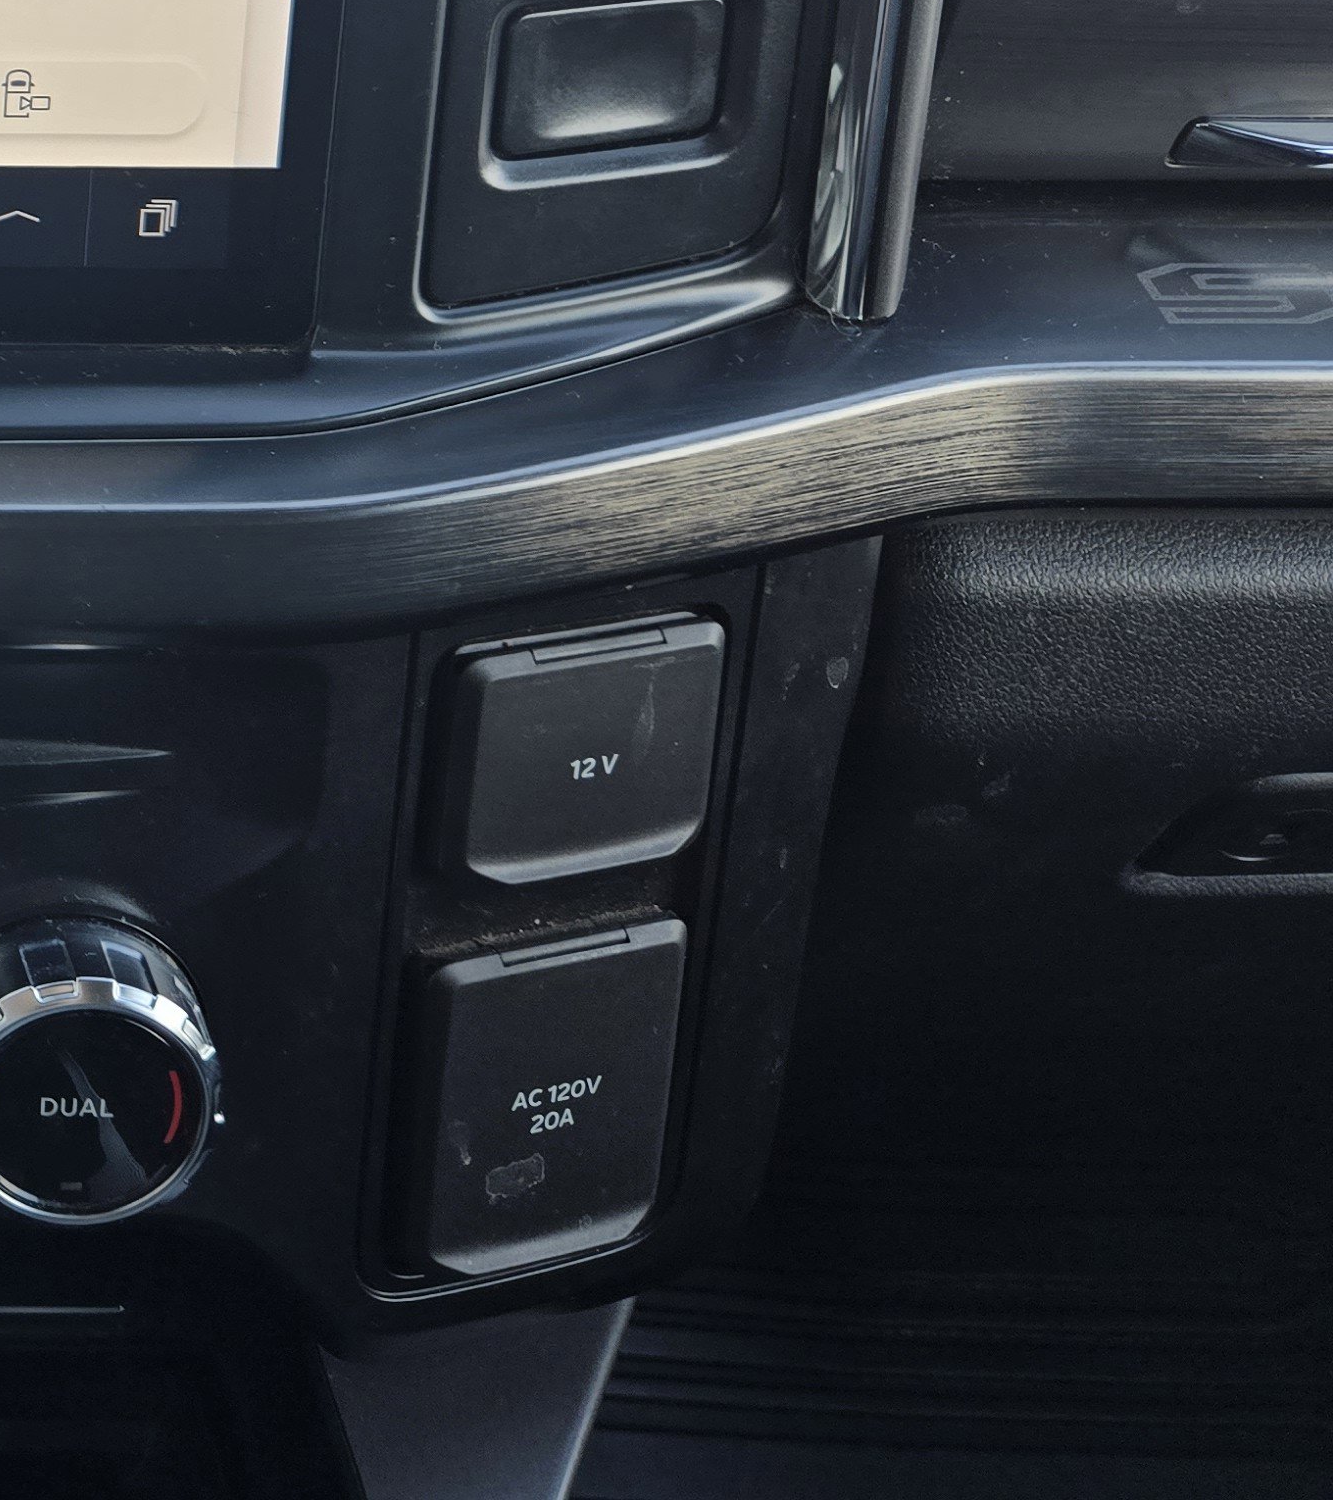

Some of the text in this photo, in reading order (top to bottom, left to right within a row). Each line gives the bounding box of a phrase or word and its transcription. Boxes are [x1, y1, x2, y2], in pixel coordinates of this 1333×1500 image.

[570, 753, 620, 780] 12 V
[511, 1074, 603, 1112] AC 120V
[40, 1096, 114, 1118] DUAL
[529, 1107, 575, 1135] 20A
